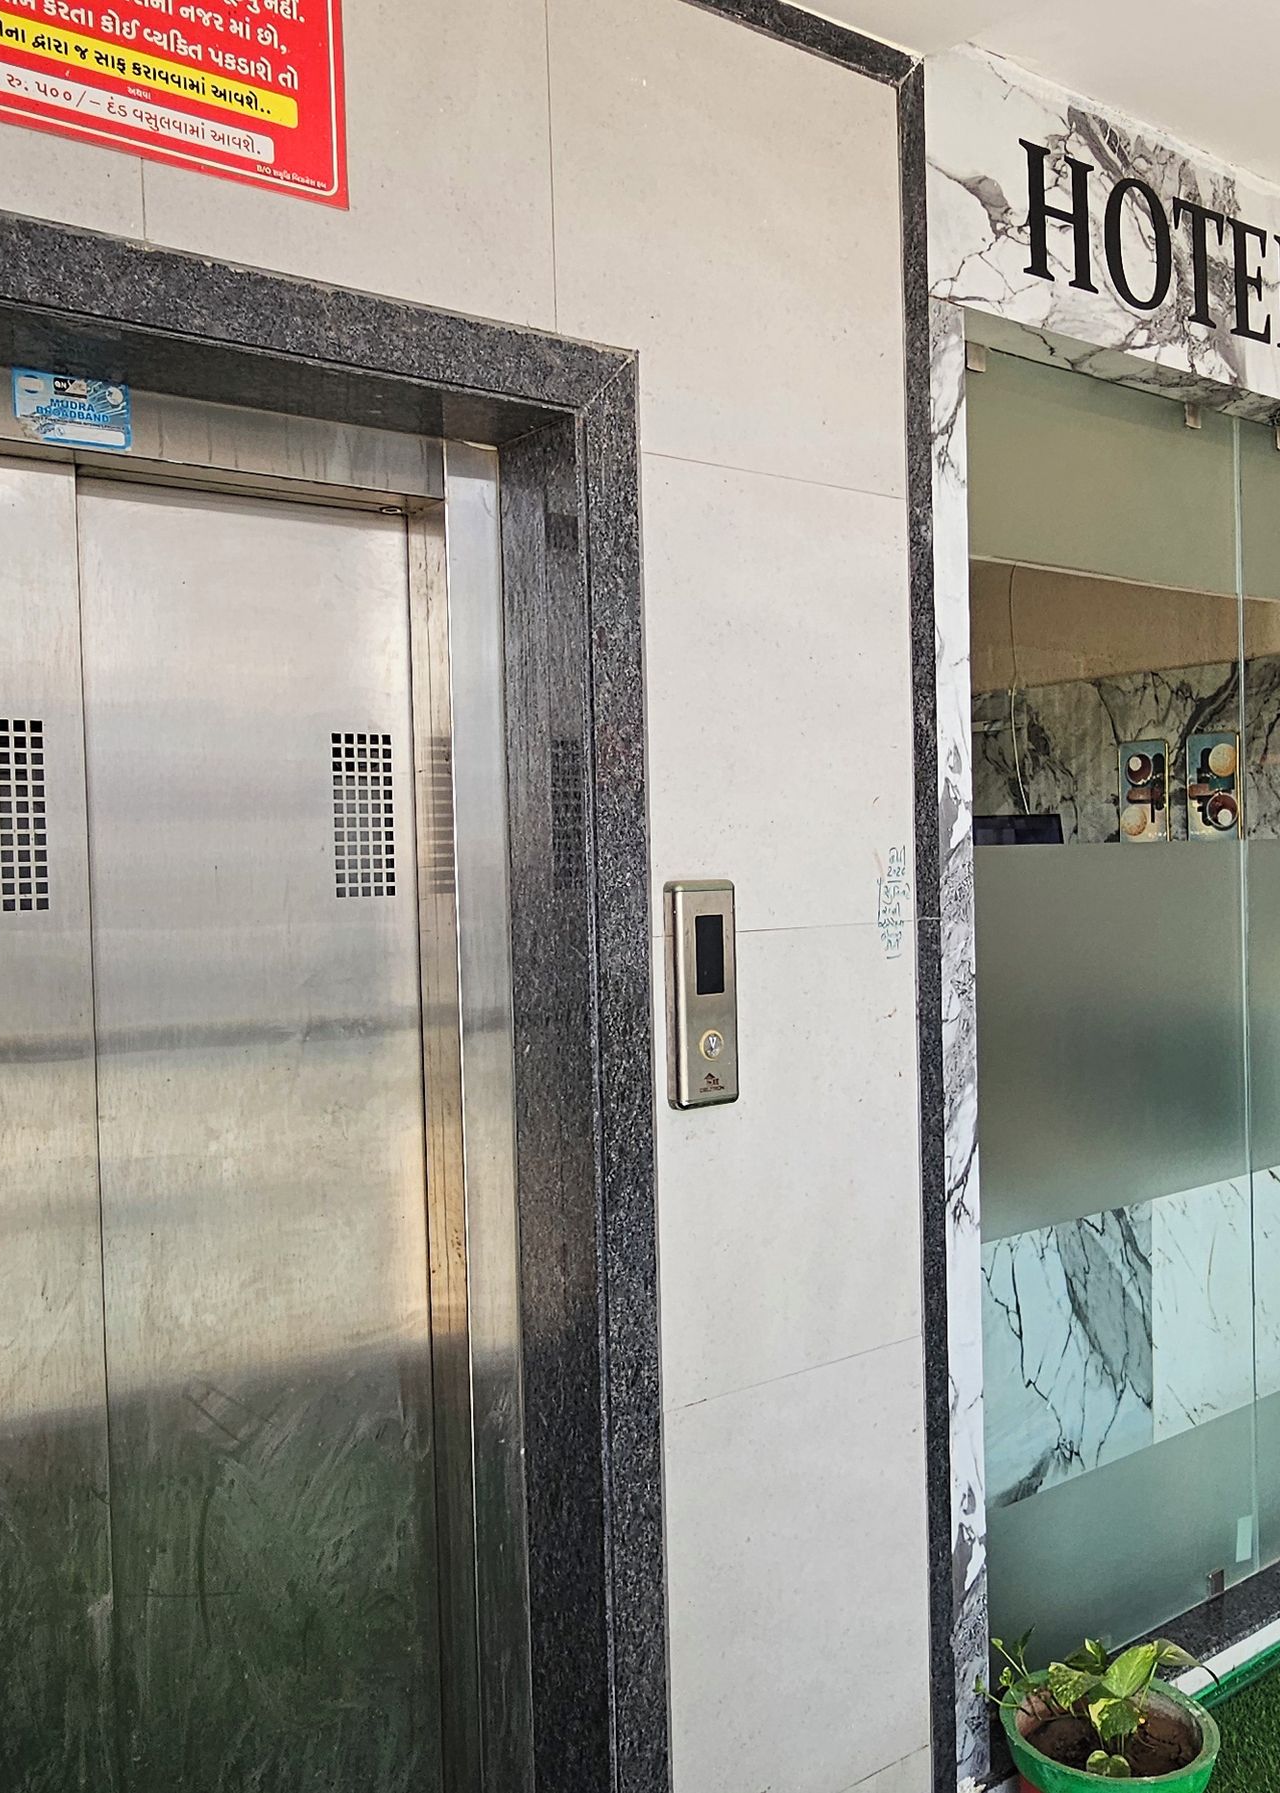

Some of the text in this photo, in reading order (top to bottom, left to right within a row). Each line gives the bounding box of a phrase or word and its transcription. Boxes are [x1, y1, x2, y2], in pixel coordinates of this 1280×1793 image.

[43, 0, 94, 28] કરતા
[101, 9, 140, 40] કોઈ
[208, 47, 272, 82] પકડાશે
[278, 65, 298, 90] તો
[179, 5, 224, 32] નજર
[229, 16, 251, 40] માં
[32, 34, 69, 55] દ્વારા
[74, 44, 89, 60] જ
[94, 50, 126, 75] સાફ
[132, 62, 206, 95] કરાવવામાં
[107, 96, 128, 119] દંડ
[132, 108, 205, 140] વસુલવામાં
[210, 129, 261, 155] આવશે.
[36, 405, 109, 423] BROADBAND
[50, 398, 95, 412] MUDRA
